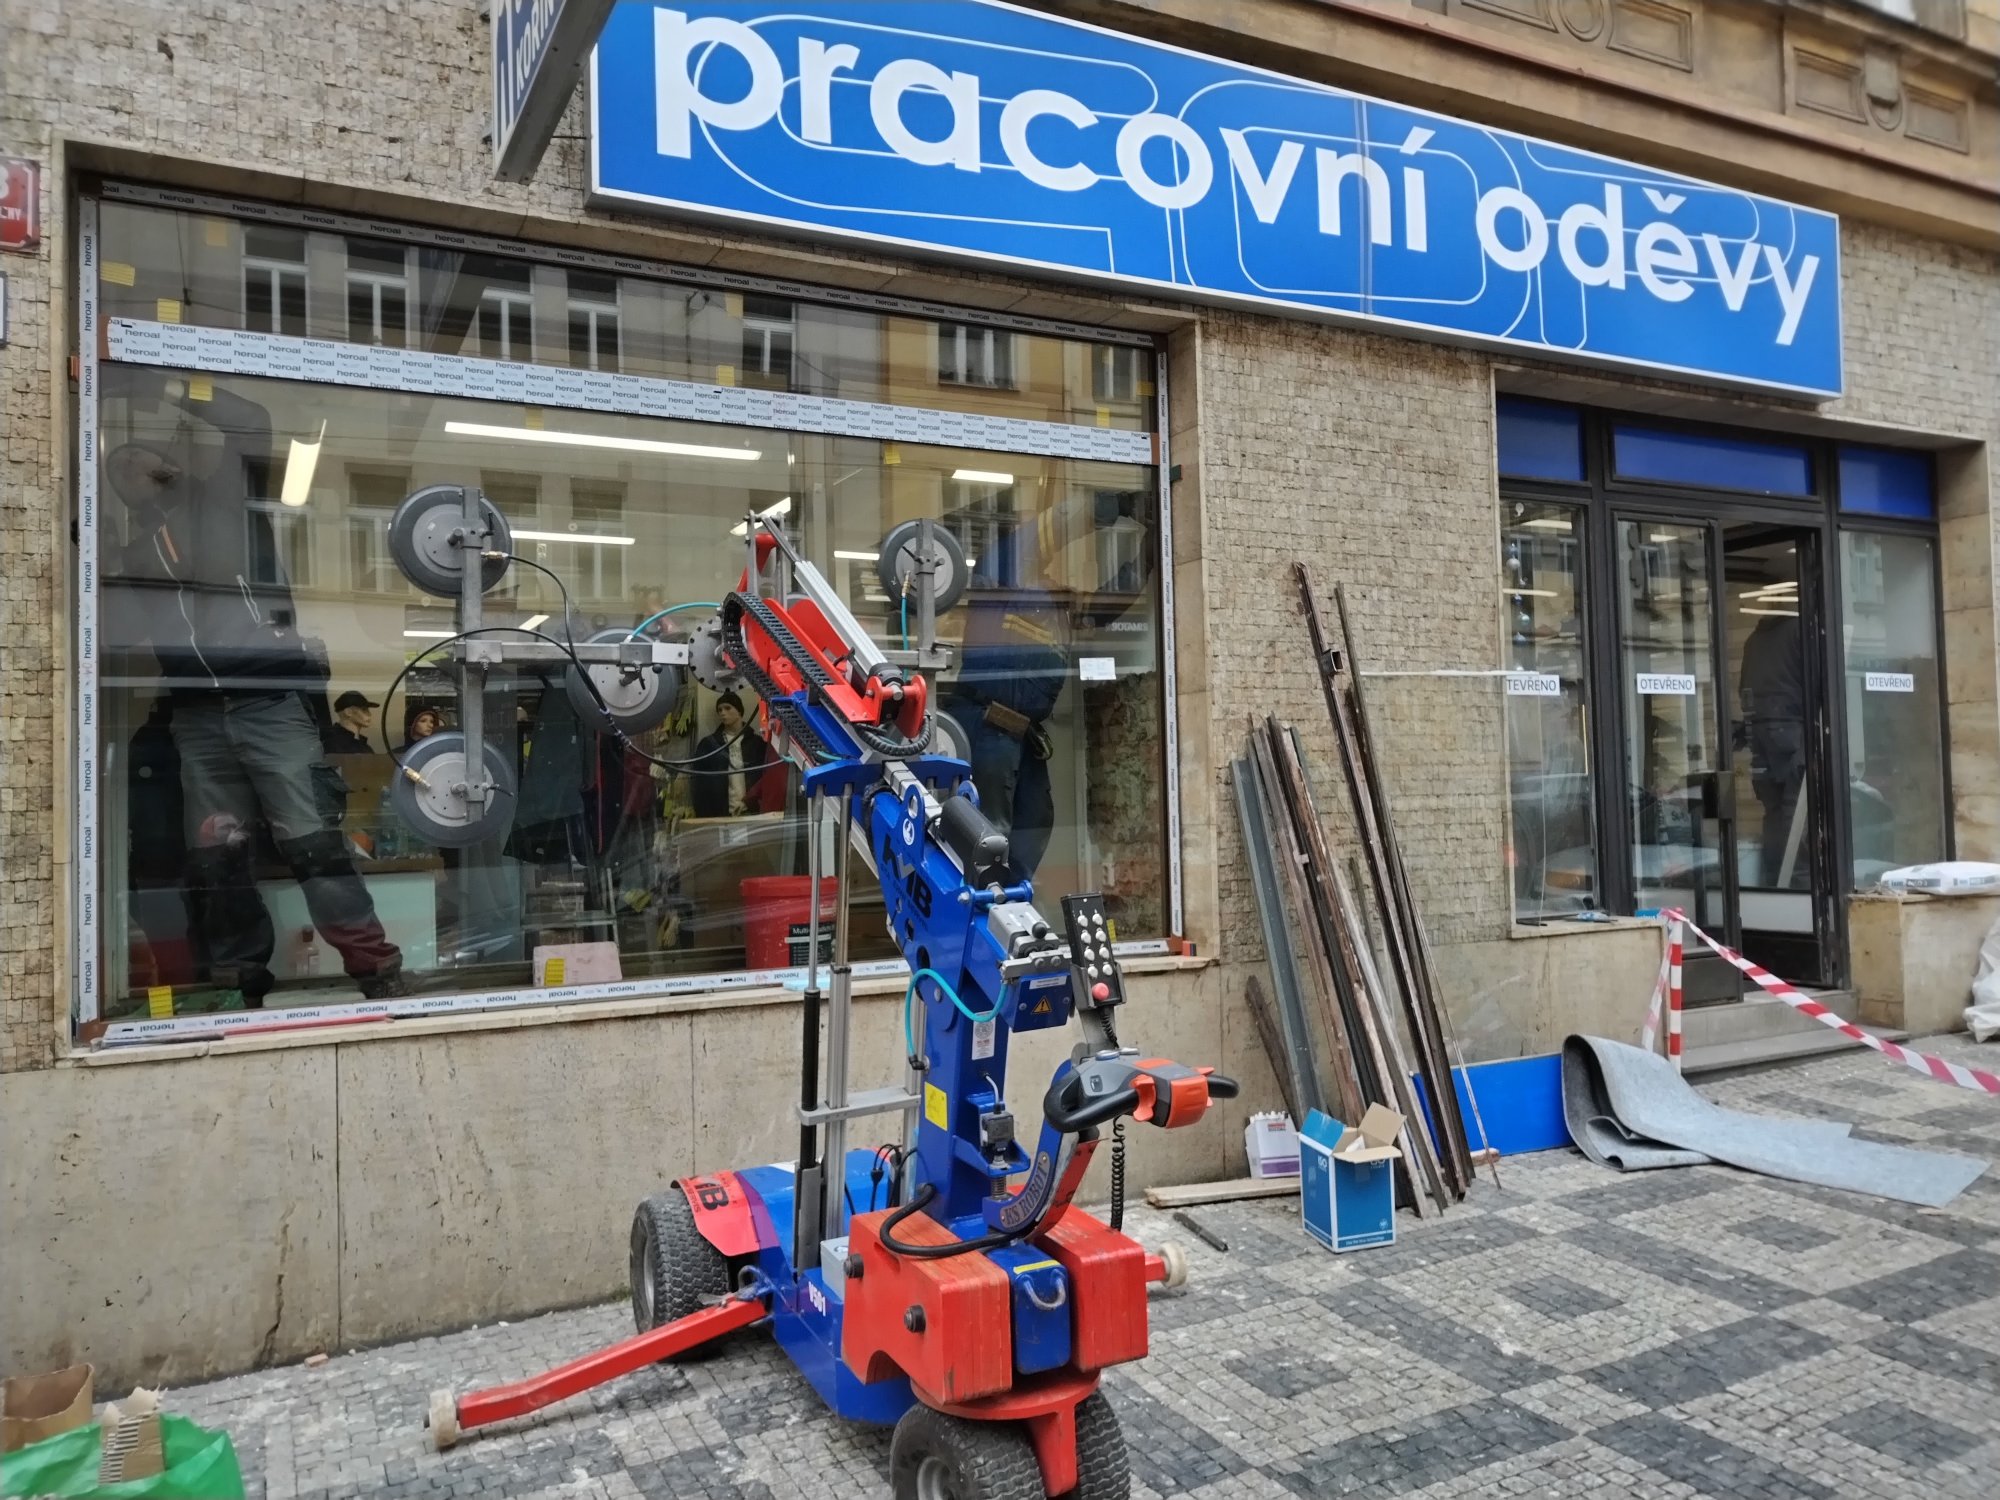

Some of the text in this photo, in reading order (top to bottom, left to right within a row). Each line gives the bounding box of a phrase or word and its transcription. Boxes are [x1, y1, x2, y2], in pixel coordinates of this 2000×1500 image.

[653, 6, 1820, 346] pracovní oděvy
[102, 185, 119, 193] oal
[160, 193, 194, 204] heroal
[232, 203, 266, 215] heroal
[303, 214, 336, 225] heroal
[370, 224, 402, 235] heroal
[434, 234, 465, 244] heroal
[497, 243, 526, 253] heroal
[557, 252, 585, 261] heroal
[615, 260, 641, 270] heroal
[670, 268, 696, 278] heroal
[724, 276, 749, 285] heroal
[776, 283, 801, 293] heroal
[827, 291, 850, 300] heroal
[107, 336, 123, 345] oal
[162, 342, 196, 352] heroal
[234, 349, 267, 359] heroal
[303, 356, 335, 367] heroal
[369, 363, 400, 374] heroal
[434, 370, 463, 381] heroal
[495, 377, 524, 387] heroal
[555, 383, 583, 394] heroal
[612, 390, 639, 400] heroal
[667, 396, 694, 405] heroal
[721, 402, 746, 411] heroal
[773, 407, 797, 416] heroal
[823, 413, 846, 421] heroal
[125, 329, 160, 339] heroal
[198, 337, 232, 347] heroal
[269, 344, 301, 354] heroal
[336, 352, 368, 362] heroal
[402, 359, 432, 369] heroal
[465, 366, 494, 375] heroal
[525, 373, 554, 382] heroal
[584, 379, 611, 388] heroal
[640, 386, 667, 395] heroal
[694, 392, 720, 400] heroal
[747, 397, 772, 406] heroal
[798, 403, 822, 411] heroal
[125, 347, 160, 357] heroal
[198, 355, 232, 365] heroal
[269, 362, 301, 372] heroal
[336, 369, 368, 379] heroal
[402, 376, 432, 386] heroal
[465, 383, 494, 392] heroal
[525, 389, 554, 399] heroal
[584, 395, 611, 405] heroal
[640, 401, 667, 410] heroal
[694, 407, 720, 416] heroal
[747, 413, 772, 421] heroal
[798, 418, 822, 426] heroal
[162, 323, 196, 334] heroal
[234, 331, 267, 342] heroal
[303, 339, 335, 349] heroal
[369, 346, 400, 357] heroal
[434, 354, 463, 364] heroal
[495, 361, 524, 371] heroal
[555, 367, 583, 377] heroal
[612, 374, 639, 383] heroal
[667, 380, 694, 390] heroal
[721, 387, 746, 395] heroal
[773, 392, 797, 401] heroal
[823, 398, 846, 406] heroal
[84, 235, 92, 993] heroal heroal heroal heroal heroal heroal heroal heroal heroal heroal heroal heroal
[1507, 676, 1557, 692] TEVŘENO
[1640, 676, 1692, 691] OTEVŘENO
[1868, 675, 1912, 689] OTEVŘENO
[140, 1023, 175, 1033] heroal
[215, 1016, 249, 1026] heroal
[286, 1010, 320, 1020] heroal
[356, 1005, 388, 1014] heroal
[422, 1000, 453, 1008] heroal
[487, 994, 516, 1003] heroal
[549, 990, 577, 998] heroal
[608, 985, 636, 993] heroal
[1005, 1162, 1047, 1225] KS ROBOT
